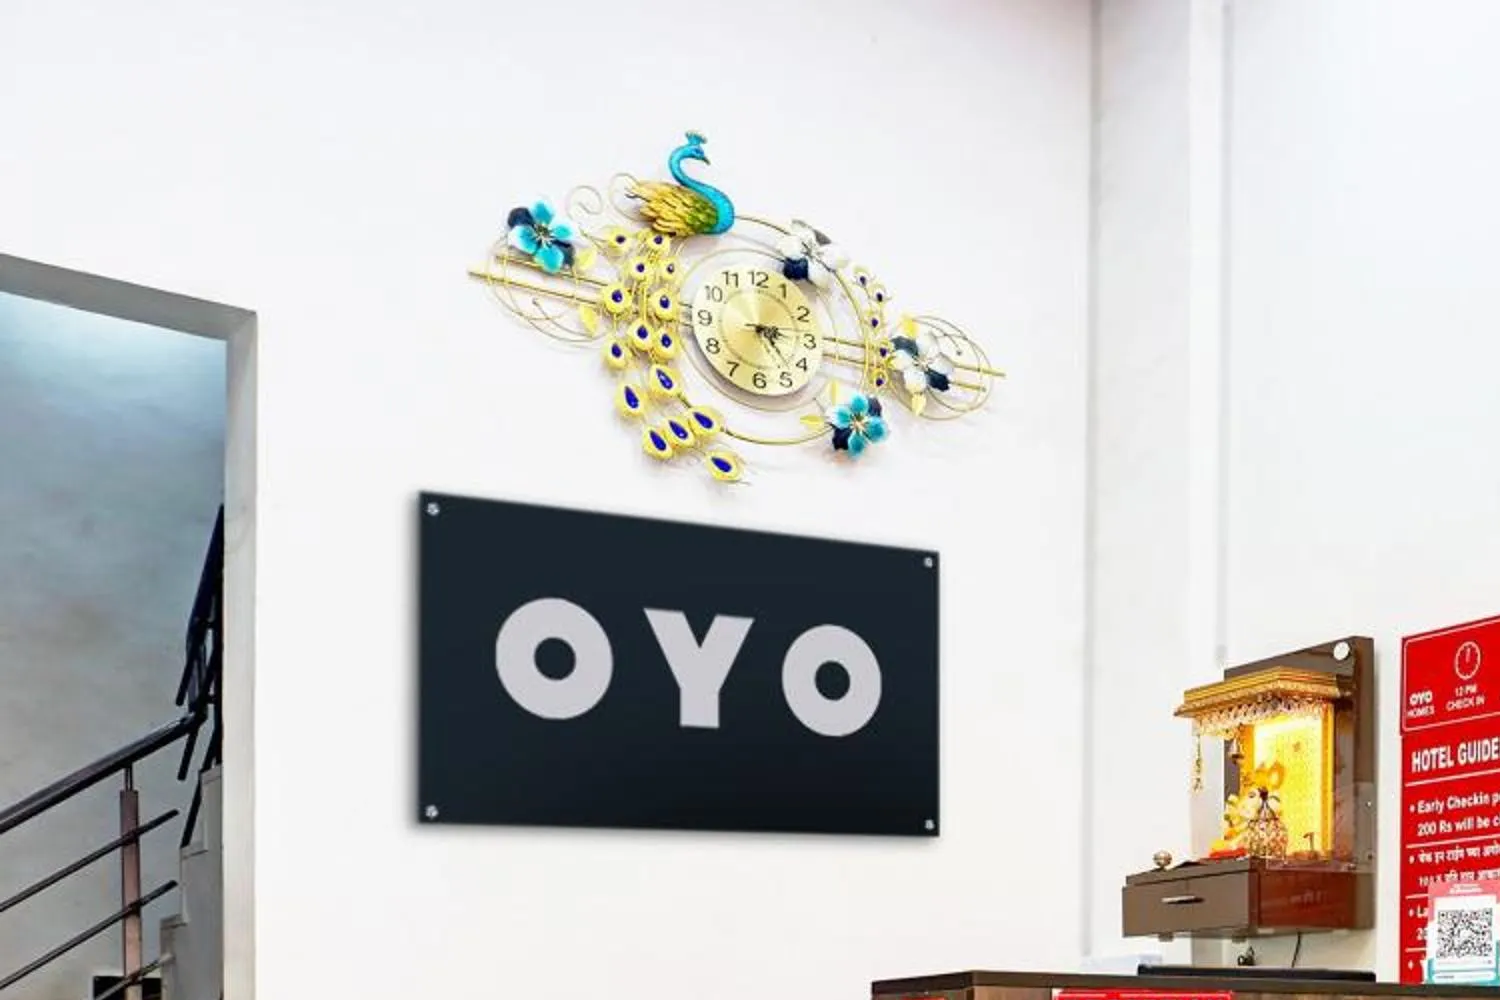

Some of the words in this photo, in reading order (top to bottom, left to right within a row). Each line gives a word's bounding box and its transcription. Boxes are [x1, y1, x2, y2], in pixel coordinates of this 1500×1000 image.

[722, 271, 739, 288] 11
[748, 271, 769, 288] 12
[704, 285, 723, 302] 10
[779, 283, 787, 299] 1
[697, 309, 712, 326] 9
[796, 306, 810, 322] 2
[705, 337, 720, 354] 8
[803, 333, 817, 350] 3
[726, 361, 740, 377] 7
[795, 357, 808, 372] 4
[752, 372, 767, 388] 6
[779, 371, 793, 388] 5
[495, 597, 882, 737] OYO
[1409, 690, 1433, 705] OYO
[1446, 698, 1474, 711] CHECK
[1475, 695, 1485, 706] IN
[1412, 745, 1454, 773] HOTEL
[1417, 799, 1444, 814] Early
[1447, 792, 1490, 810] Checkin
[1417, 820, 1437, 837] 200
[1439, 820, 1453, 833] Rs
[1455, 815, 1474, 831] will
[1476, 815, 1490, 829] be
